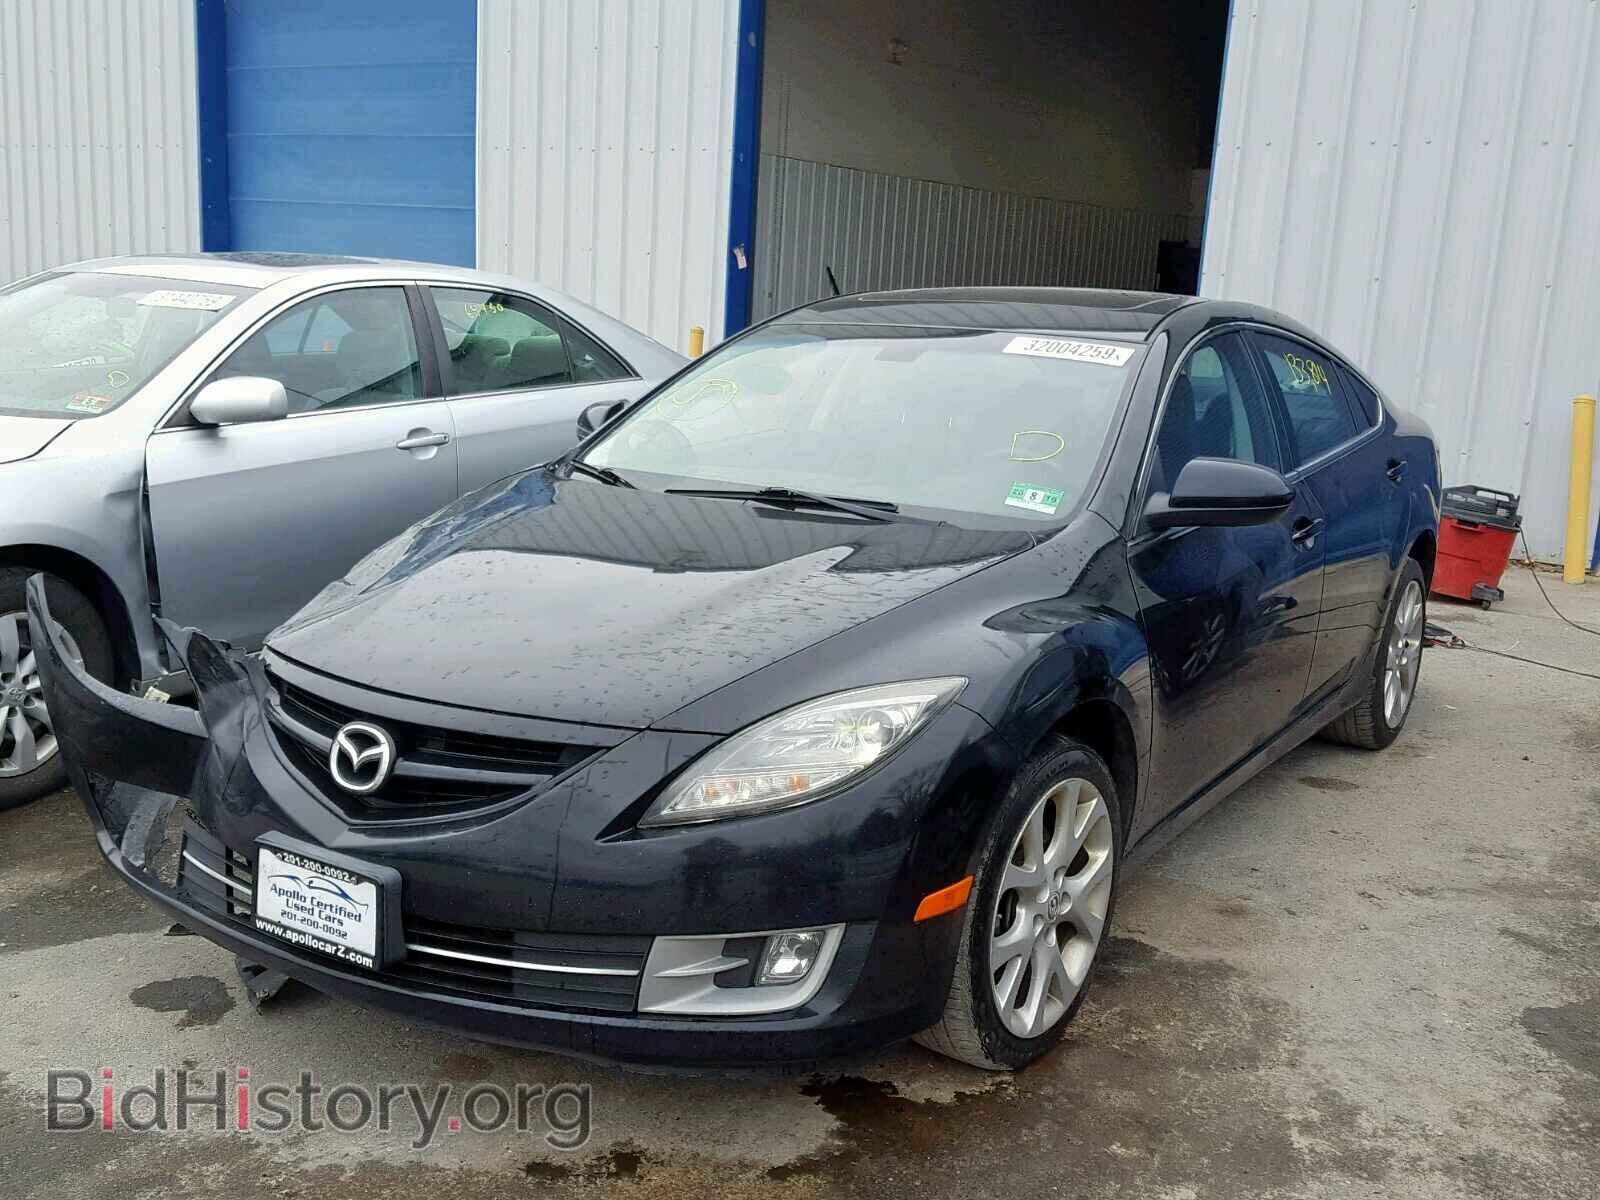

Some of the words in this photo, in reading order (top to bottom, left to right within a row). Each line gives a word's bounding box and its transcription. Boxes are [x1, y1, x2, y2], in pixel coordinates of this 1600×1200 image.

[1023, 339, 1116, 360] 32004259
[1008, 430, 1064, 461] D
[270, 883, 306, 903] Apollo
[310, 896, 362, 923] Certified
[286, 898, 315, 917] Used
[318, 909, 344, 928] Cars
[280, 909, 348, 940] 201-200-0092
